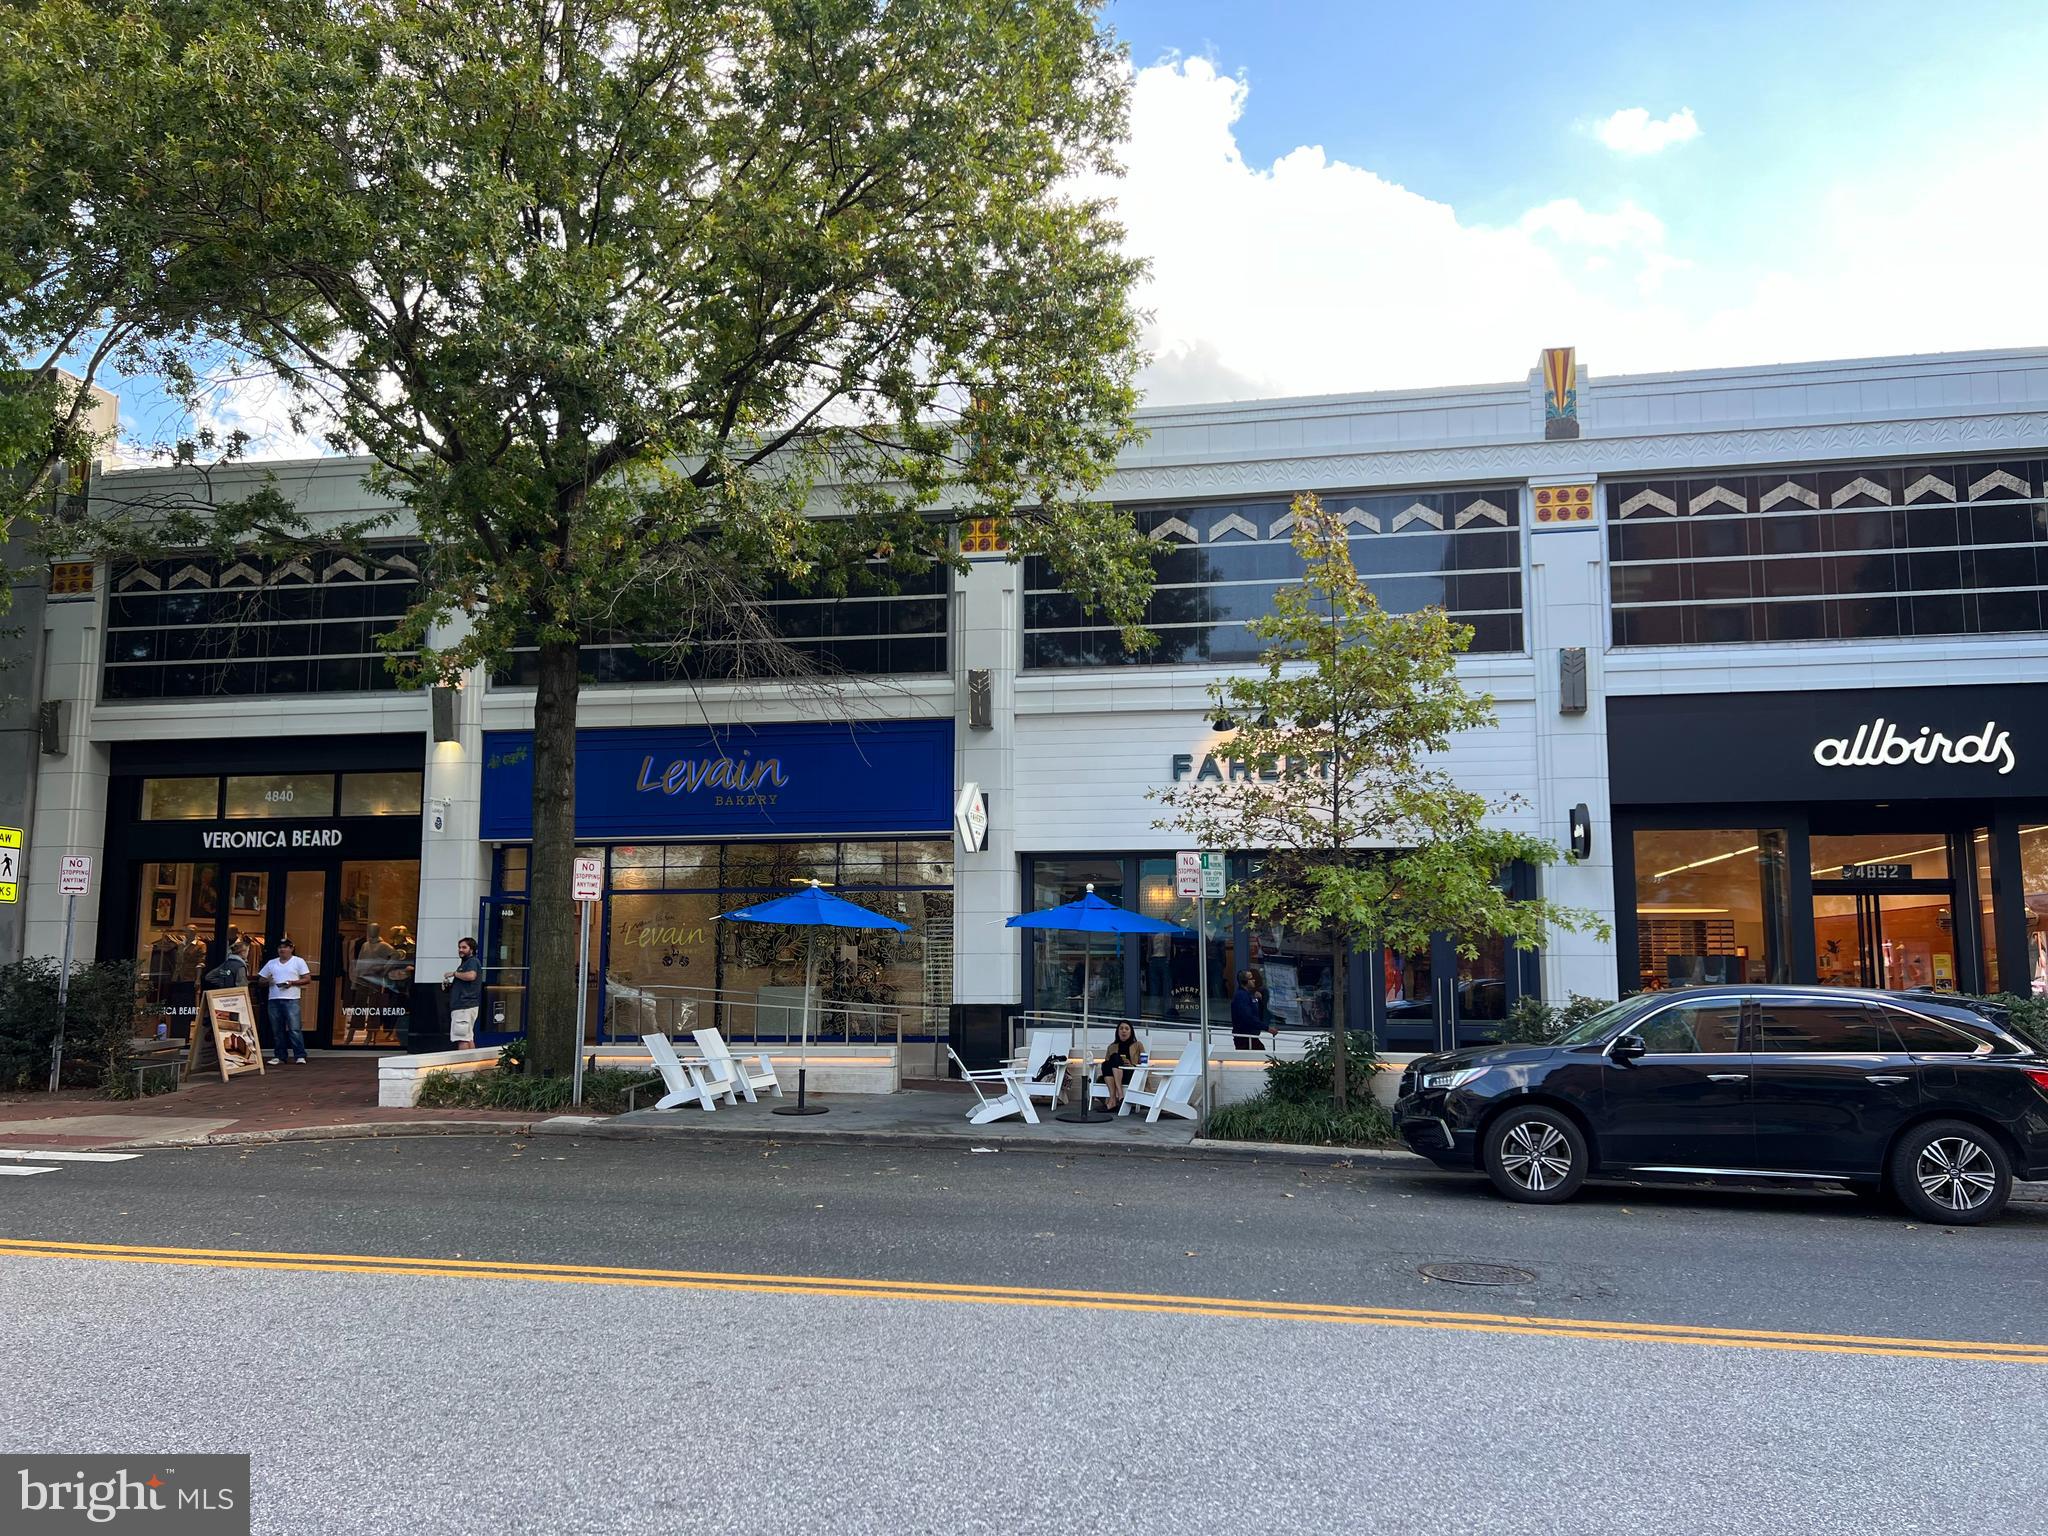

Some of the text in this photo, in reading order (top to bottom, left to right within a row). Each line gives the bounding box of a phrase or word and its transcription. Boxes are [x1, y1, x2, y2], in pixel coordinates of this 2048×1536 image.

[1812, 717, 2016, 775] allbirds
[636, 750, 789, 795] Levain
[264, 790, 294, 802] 4840
[715, 794, 778, 807] BAKERY
[202, 829, 343, 849] VERONICA BEARD
[69, 859, 83, 868] NO
[582, 863, 595, 871] NO
[1183, 856, 1194, 866] NO
[1856, 865, 1899, 879] 4852
[624, 922, 705, 948] Levain
[1171, 986, 1200, 997] FAHERT
[342, 1007, 406, 1016] VERONICA BEARD
[1175, 1003, 1200, 1011] BRAND
